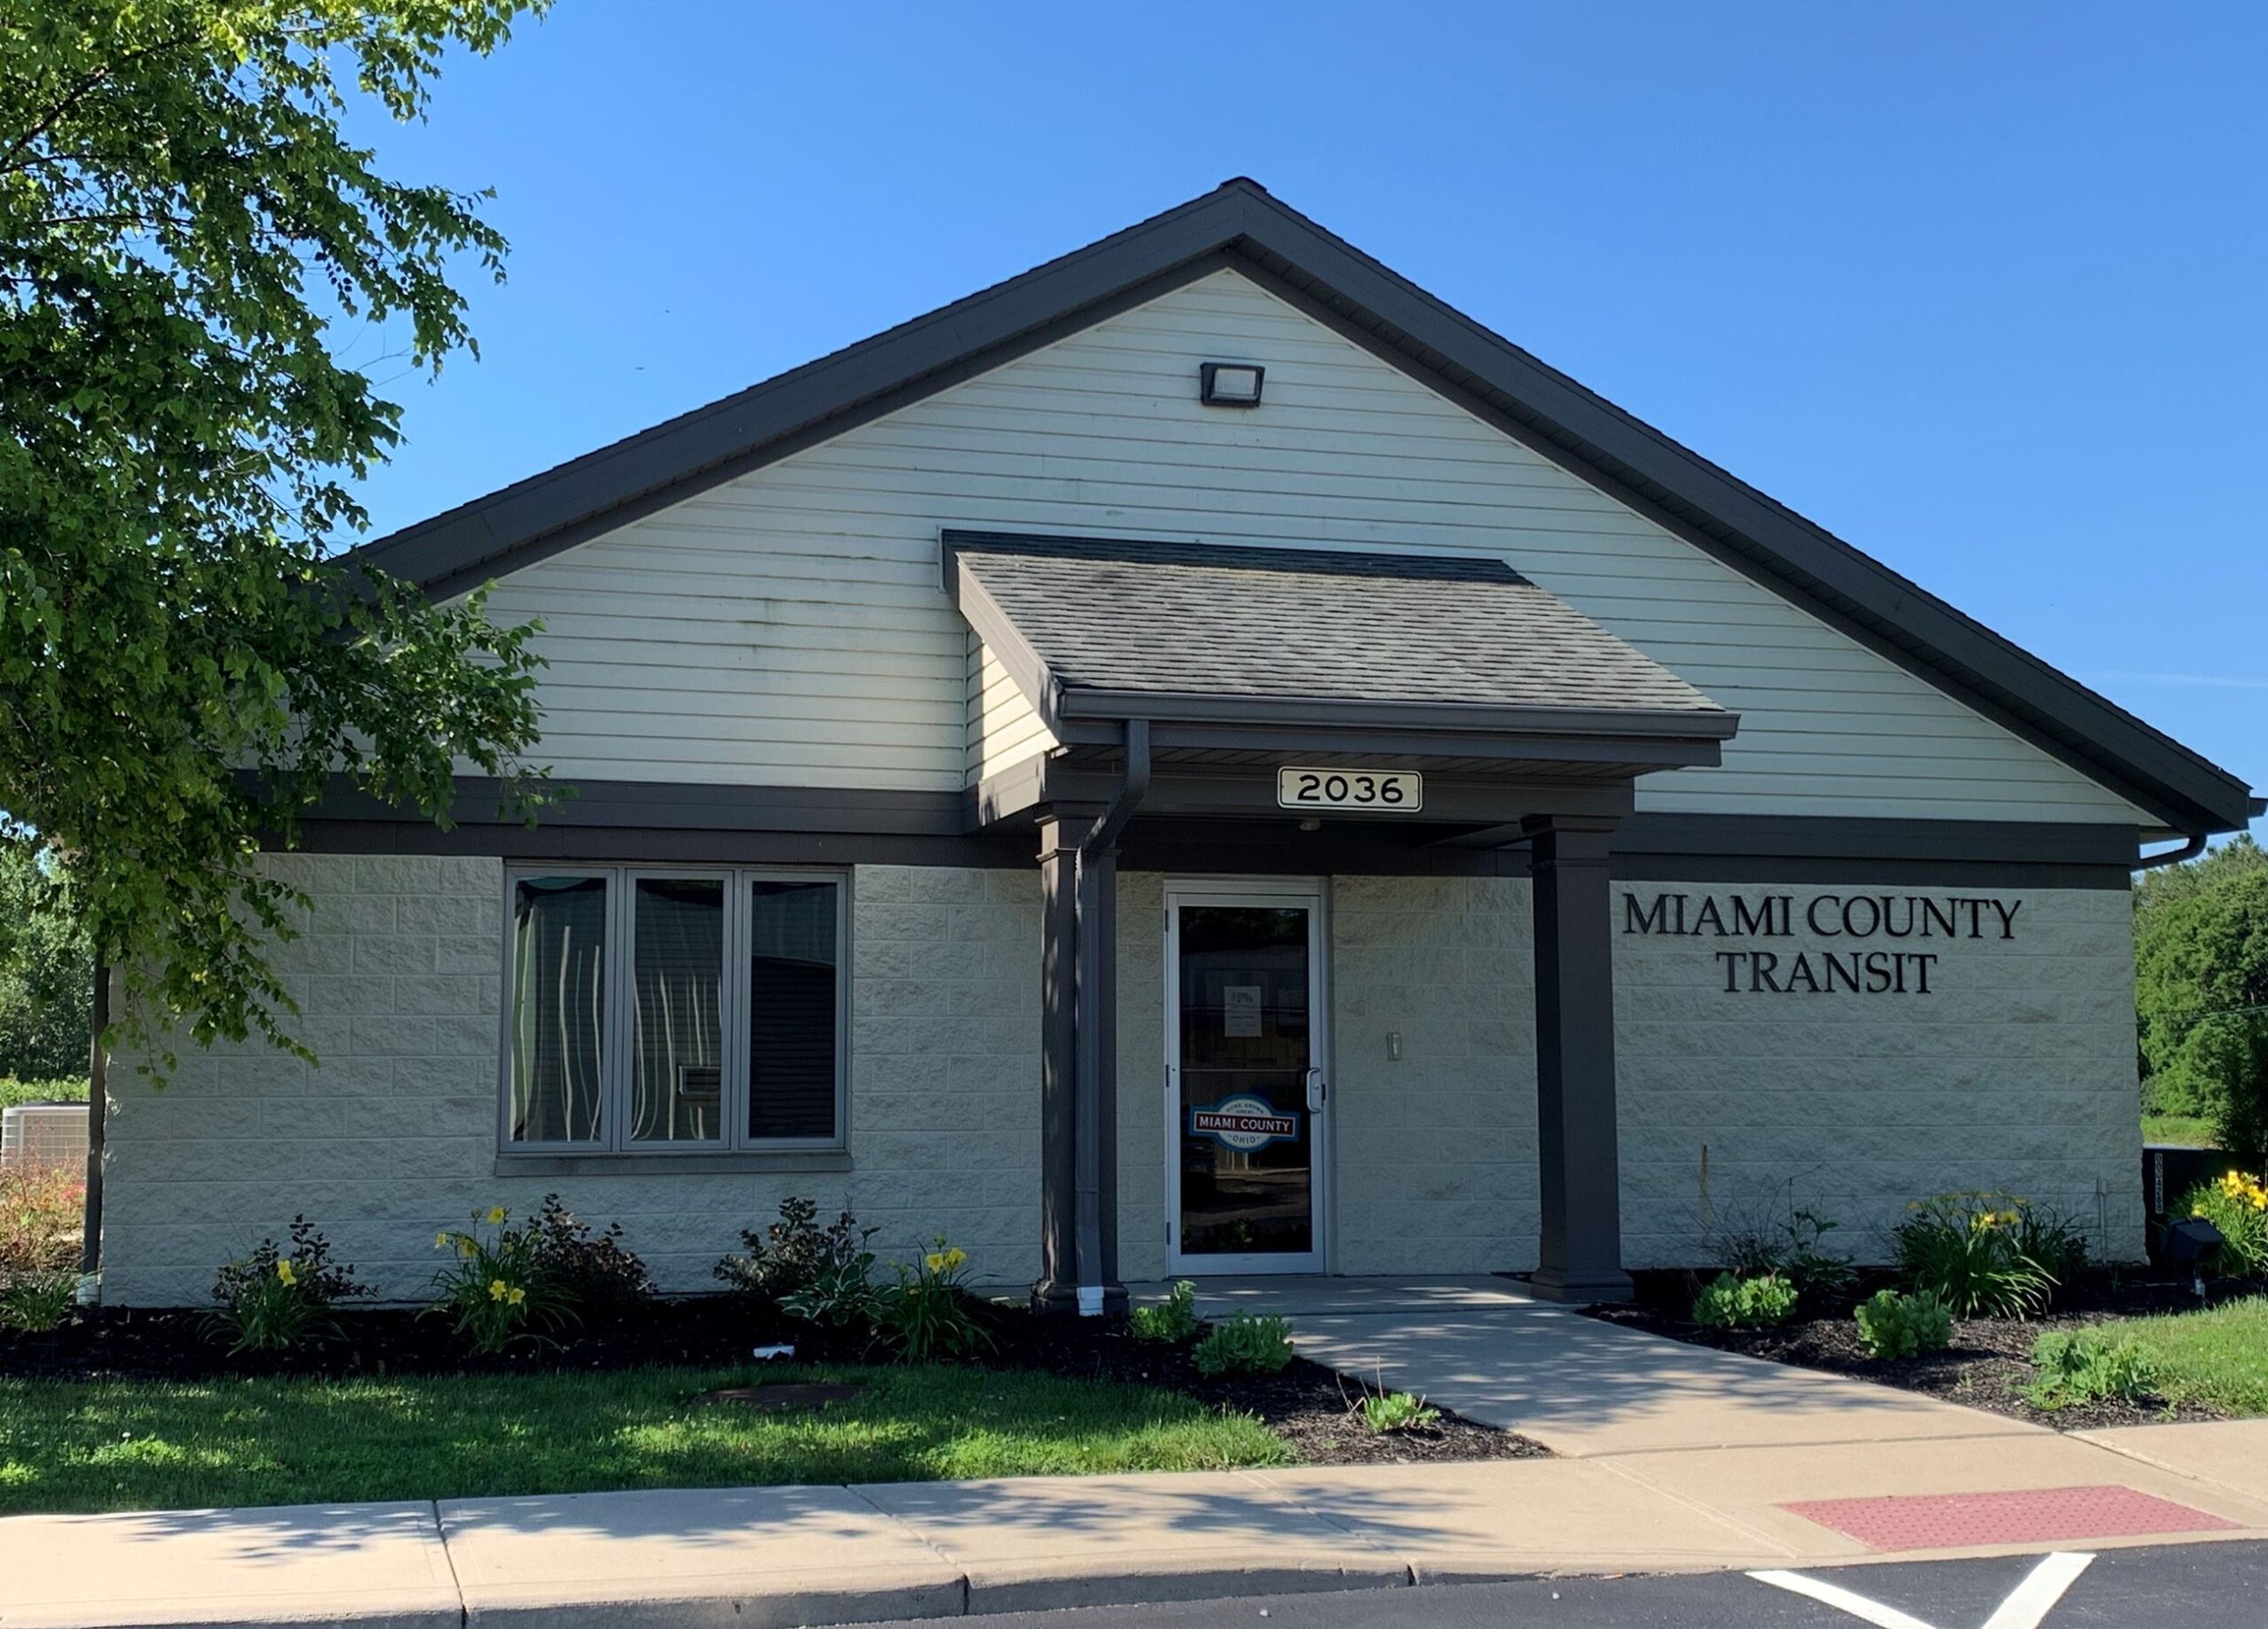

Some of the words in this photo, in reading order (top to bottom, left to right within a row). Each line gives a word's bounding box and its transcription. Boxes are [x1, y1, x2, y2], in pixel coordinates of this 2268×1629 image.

[1297, 774, 1403, 803] 2036
[1622, 893, 1795, 936] MIAMI
[1806, 895, 2023, 940] COUNTY
[1715, 951, 1938, 994] TRANSIT
[1199, 1116, 1236, 1129] MIAMI
[1240, 1119, 1290, 1131] COUNTY
